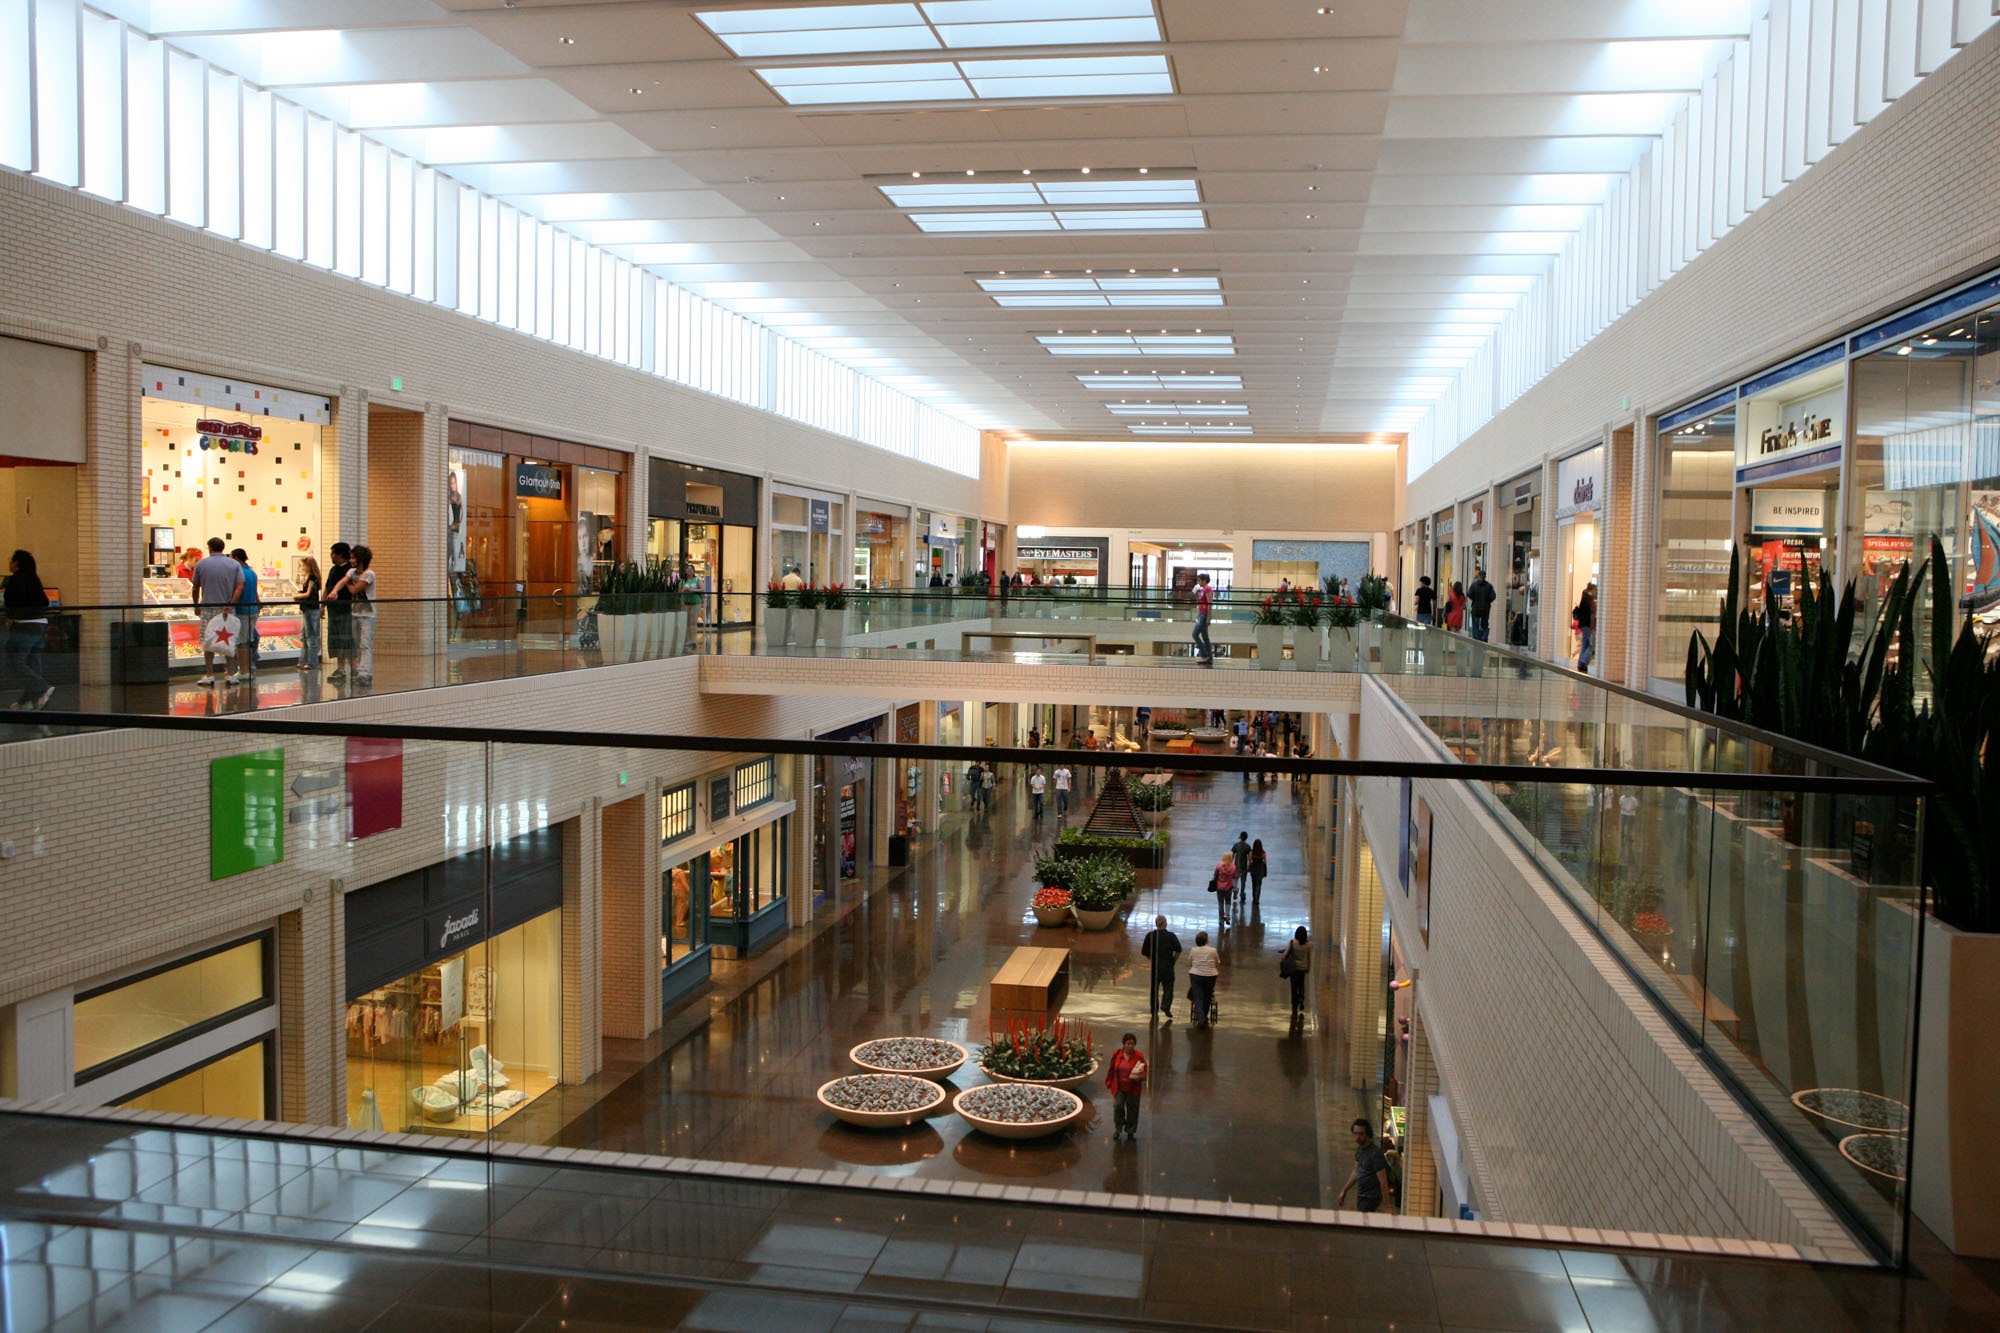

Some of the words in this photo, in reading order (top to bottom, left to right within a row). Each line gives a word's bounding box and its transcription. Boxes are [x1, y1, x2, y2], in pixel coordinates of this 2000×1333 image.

[1760, 421, 1798, 454] Finish
[1803, 414, 1832, 442] Line
[199, 435, 258, 455] COOKIES
[518, 475, 549, 488] Glamour
[1773, 506, 1783, 515] BE
[1784, 506, 1820, 516] INSPIRED
[1034, 548, 1093, 558] EYEMASTERS
